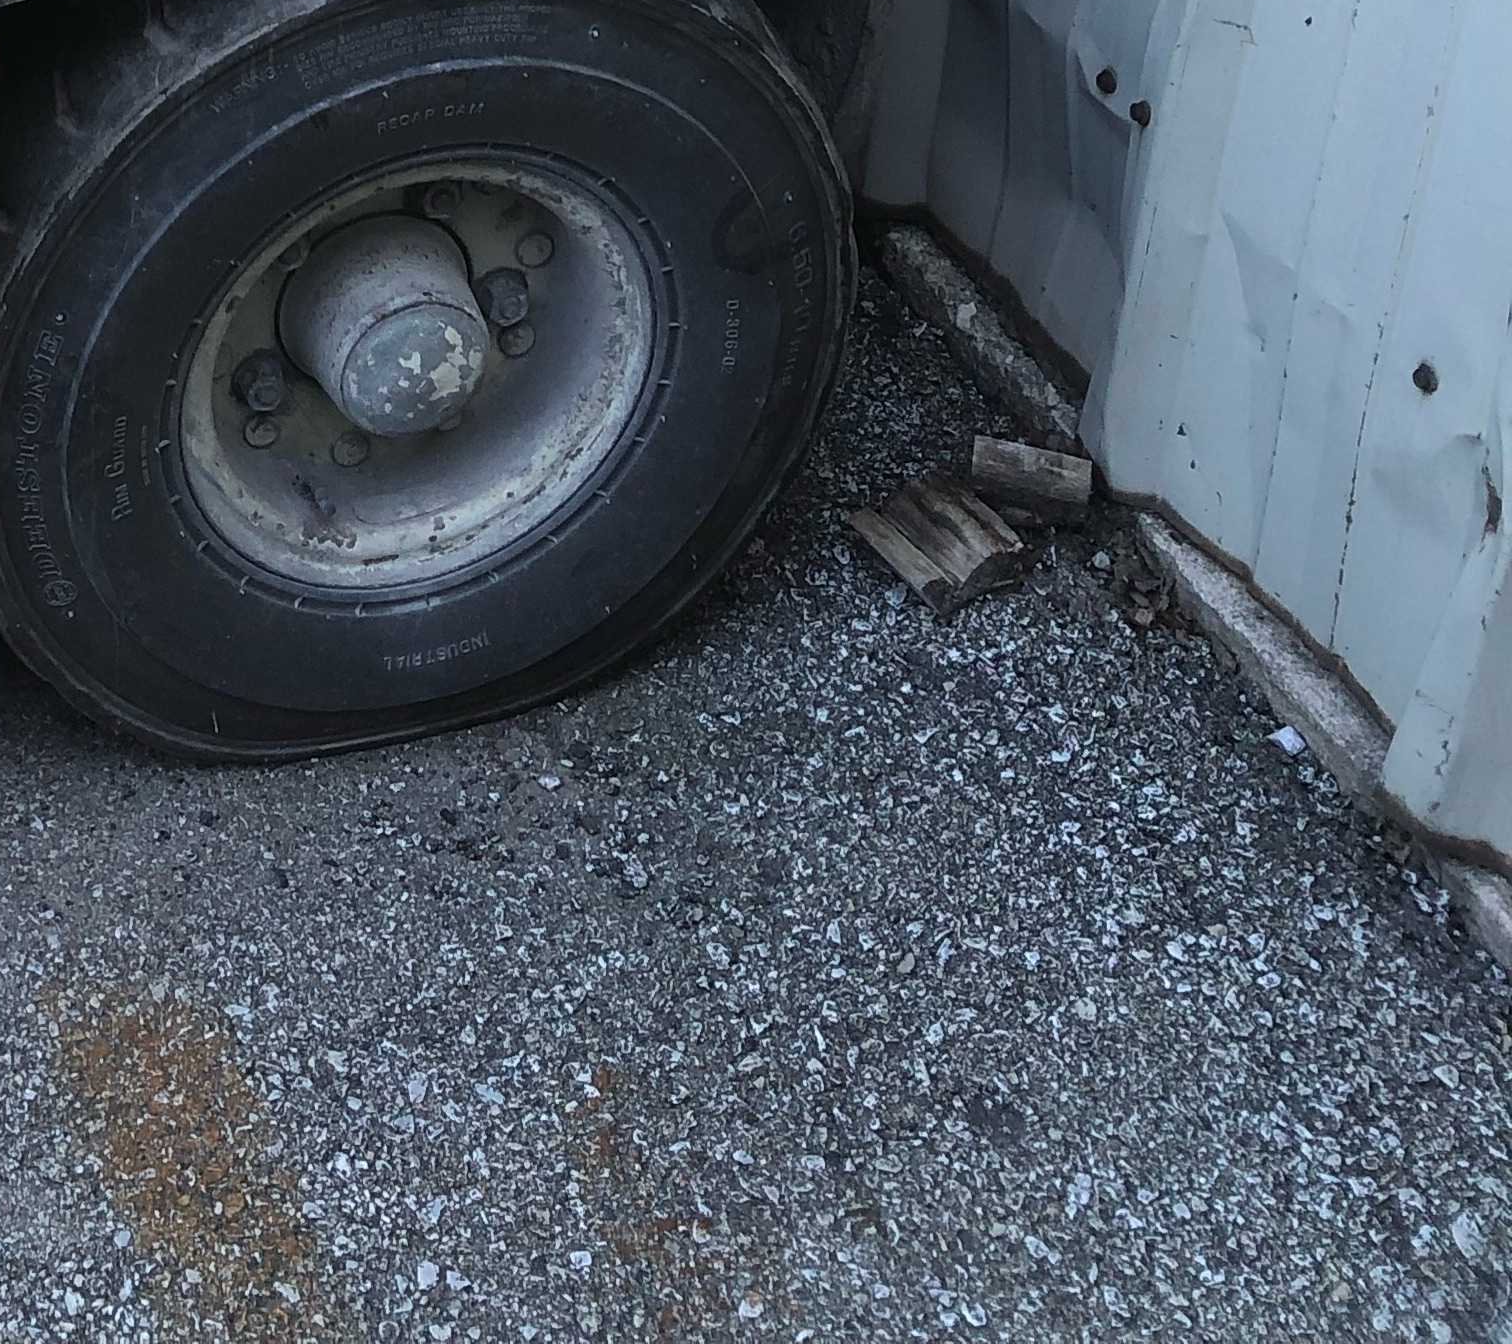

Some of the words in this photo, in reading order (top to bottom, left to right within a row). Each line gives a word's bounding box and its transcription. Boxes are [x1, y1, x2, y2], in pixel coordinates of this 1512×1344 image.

[376, 108, 435, 136] RECAP
[444, 102, 485, 117] DAM
[15, 330, 65, 578] DEESTONE
[383, 632, 489, 672] INDUSTRIAL
